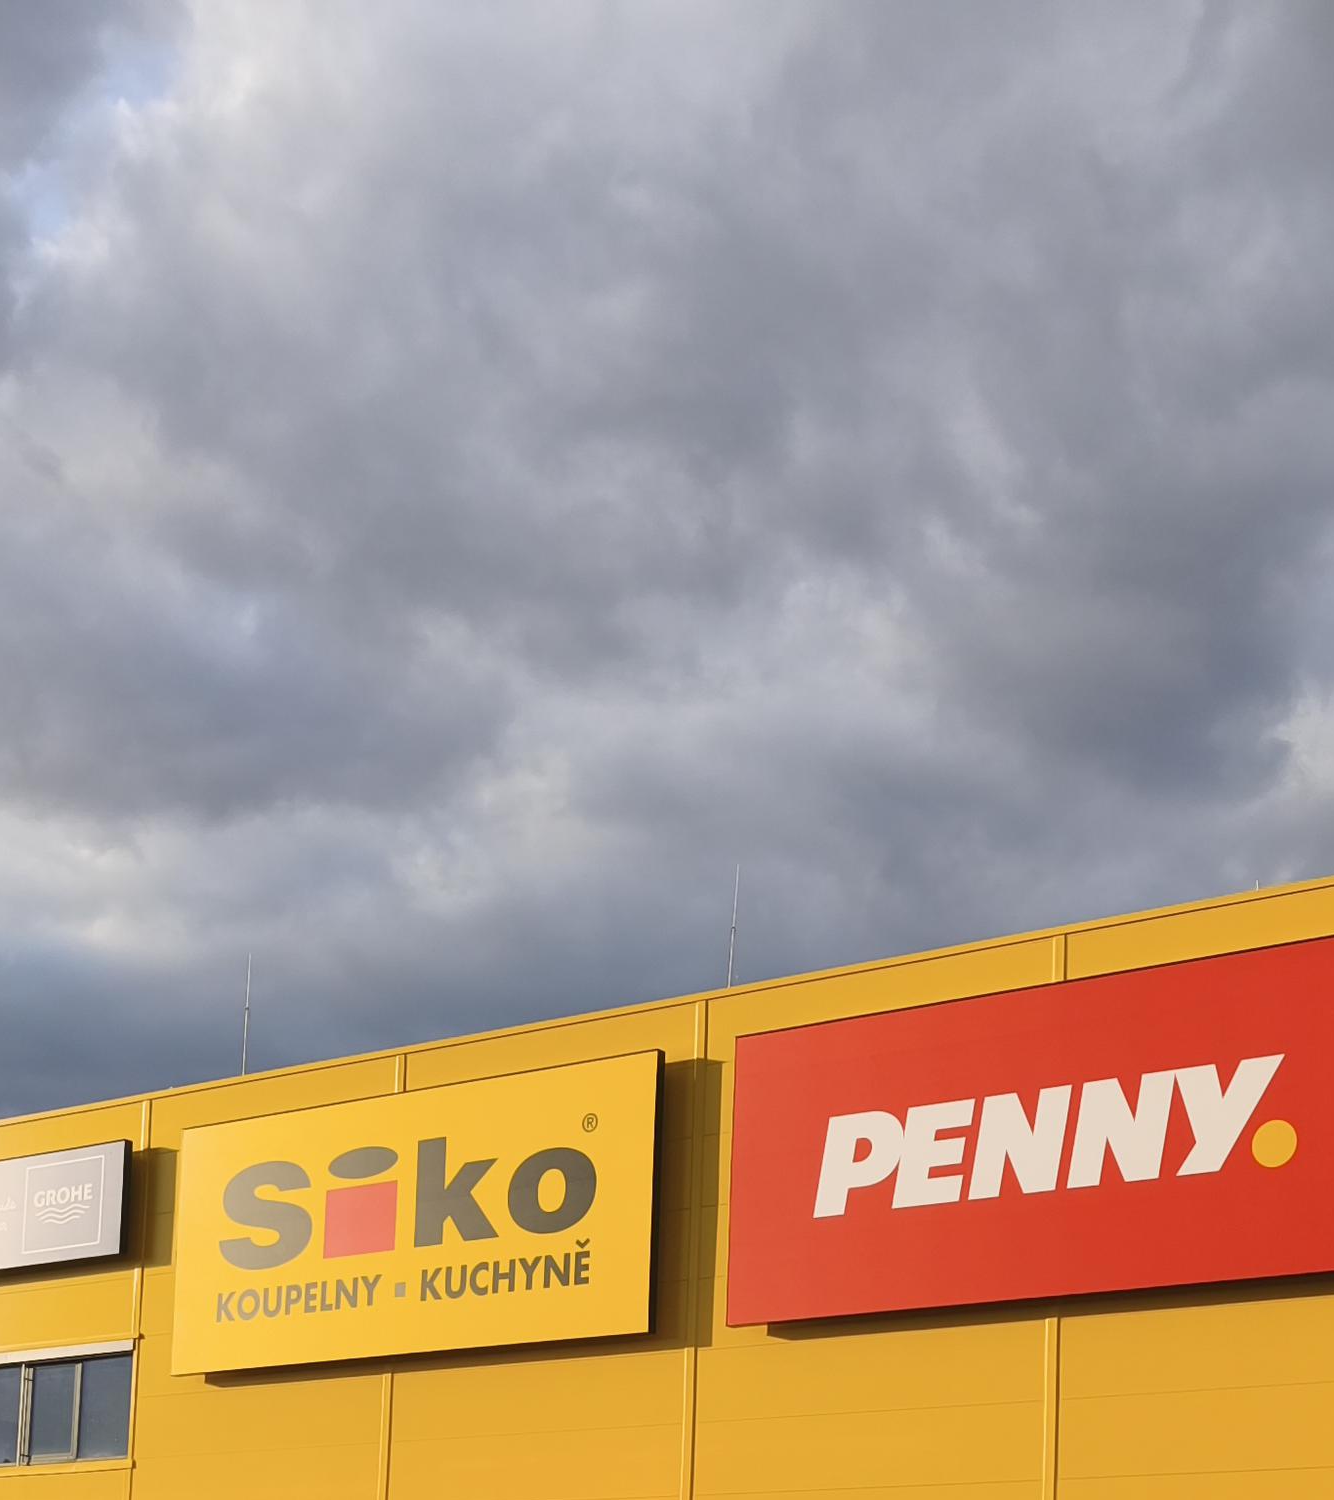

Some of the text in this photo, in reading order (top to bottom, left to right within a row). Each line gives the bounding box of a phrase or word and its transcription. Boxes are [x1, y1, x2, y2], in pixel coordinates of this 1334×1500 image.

[34, 1183, 94, 1208] GROHE
[216, 1238, 592, 1323] KOUPELNY KUCHYNĚ
